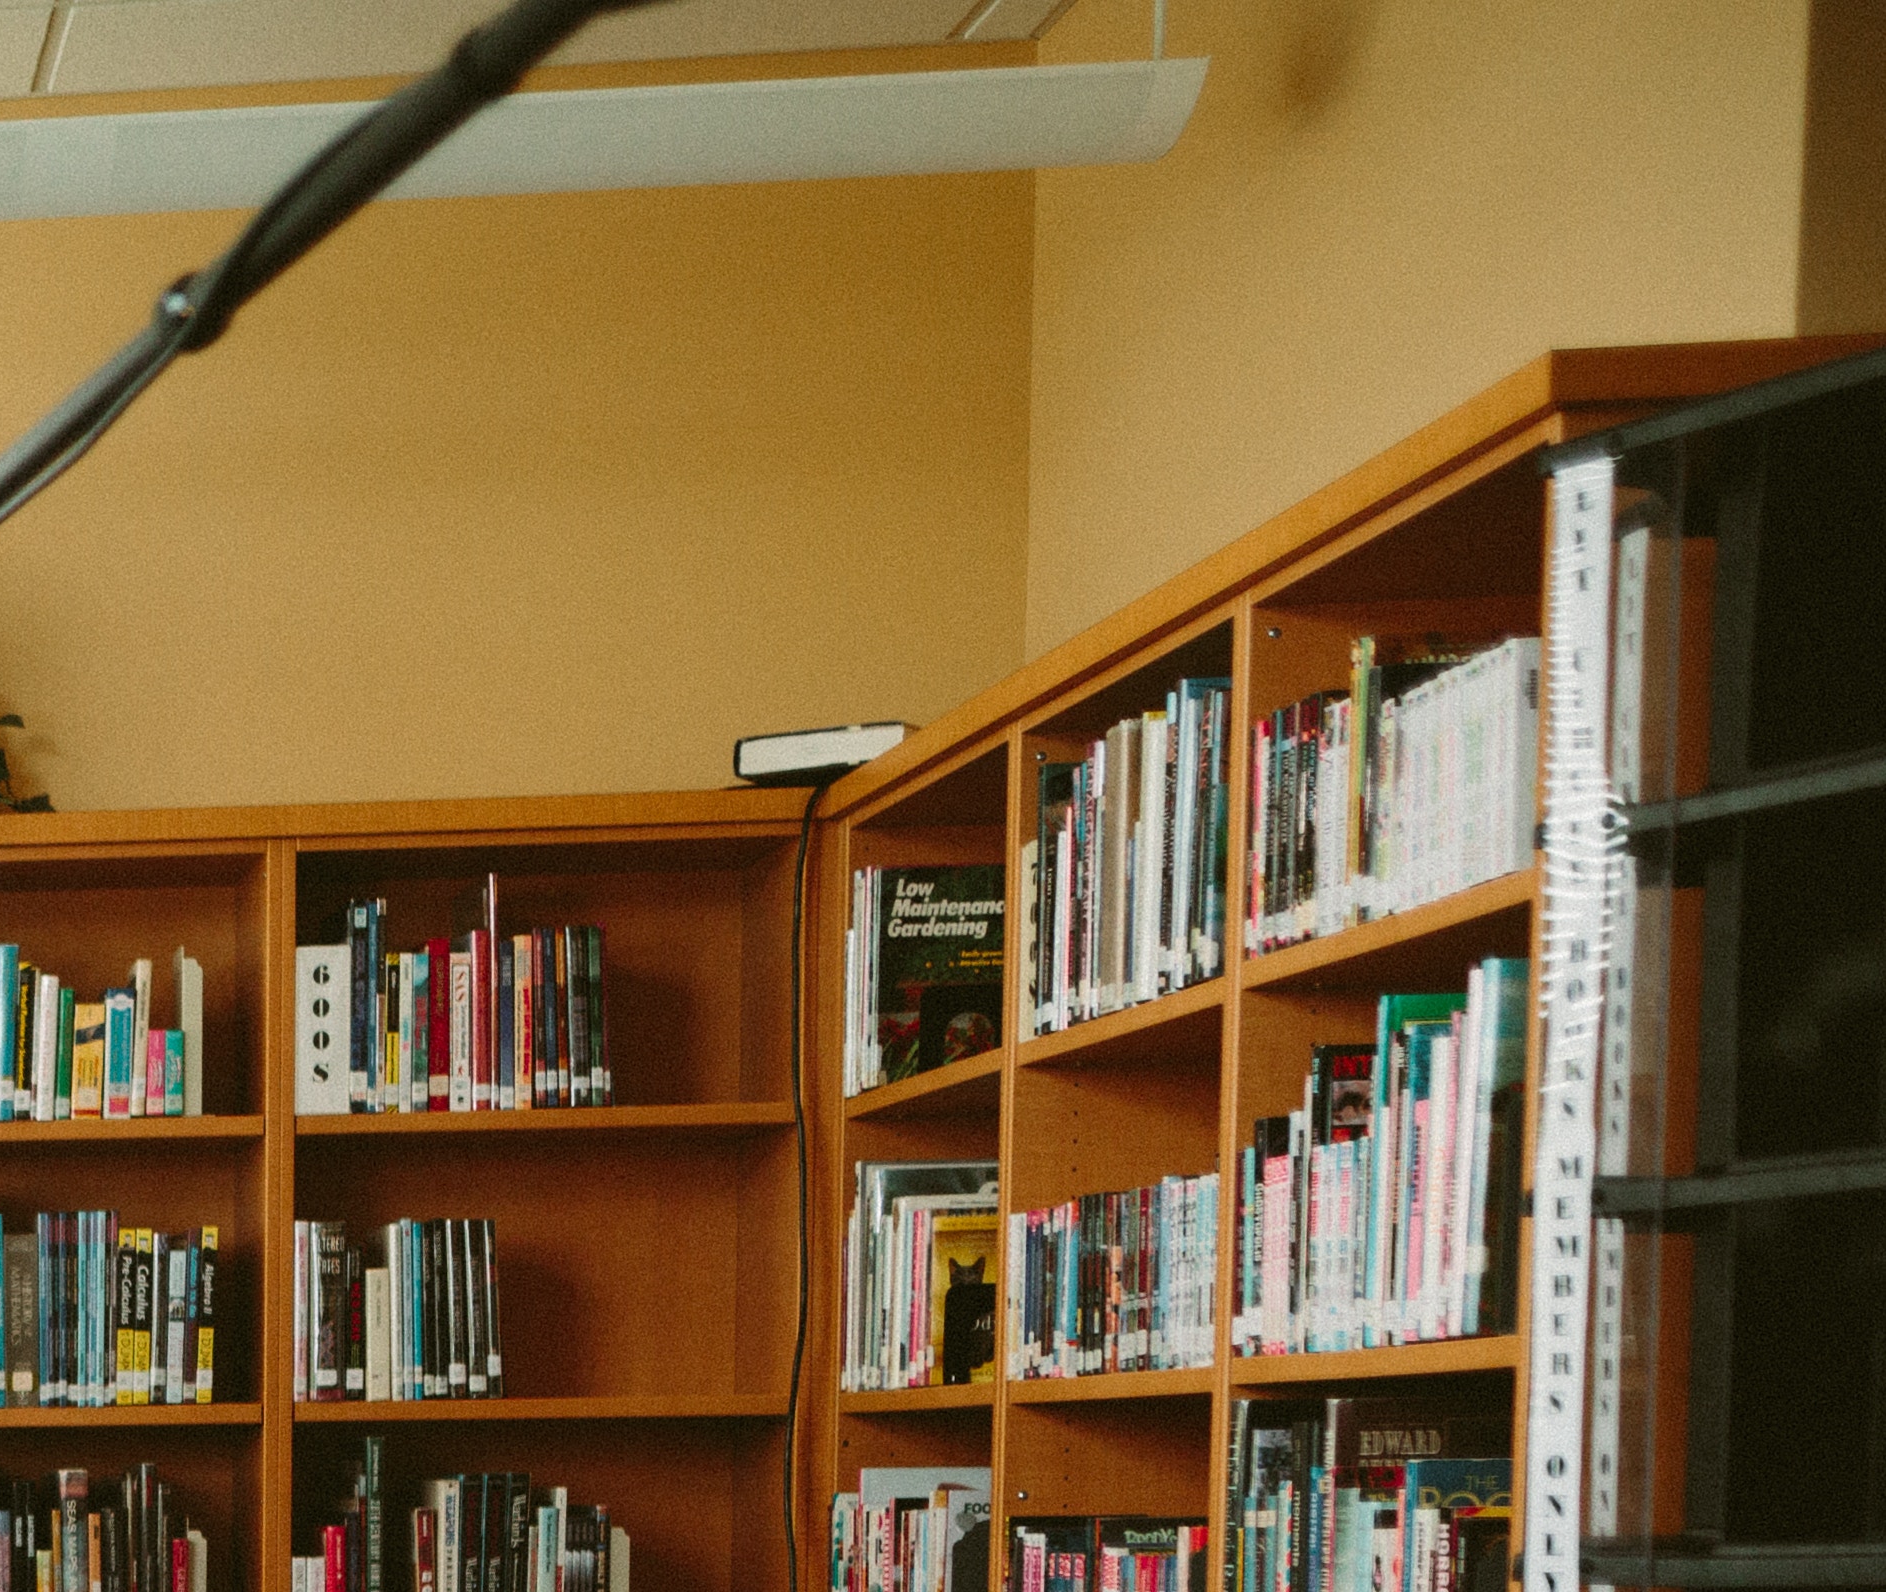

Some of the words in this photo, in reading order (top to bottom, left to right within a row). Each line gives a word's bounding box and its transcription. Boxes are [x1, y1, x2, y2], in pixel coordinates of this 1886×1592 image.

[896, 877, 936, 898] Low
[887, 916, 989, 940] Gardening
[119, 1255, 133, 1326] Pre-Calculus
[135, 1264, 150, 1321] Calculus
[202, 1262, 215, 1305] Algebra
[9, 1265, 22, 1346] MATHEMATICS
[1358, 1429, 1441, 1456] EDWARD
[1465, 1475, 1500, 1490] THE
[1292, 1490, 1301, 1568] moments
